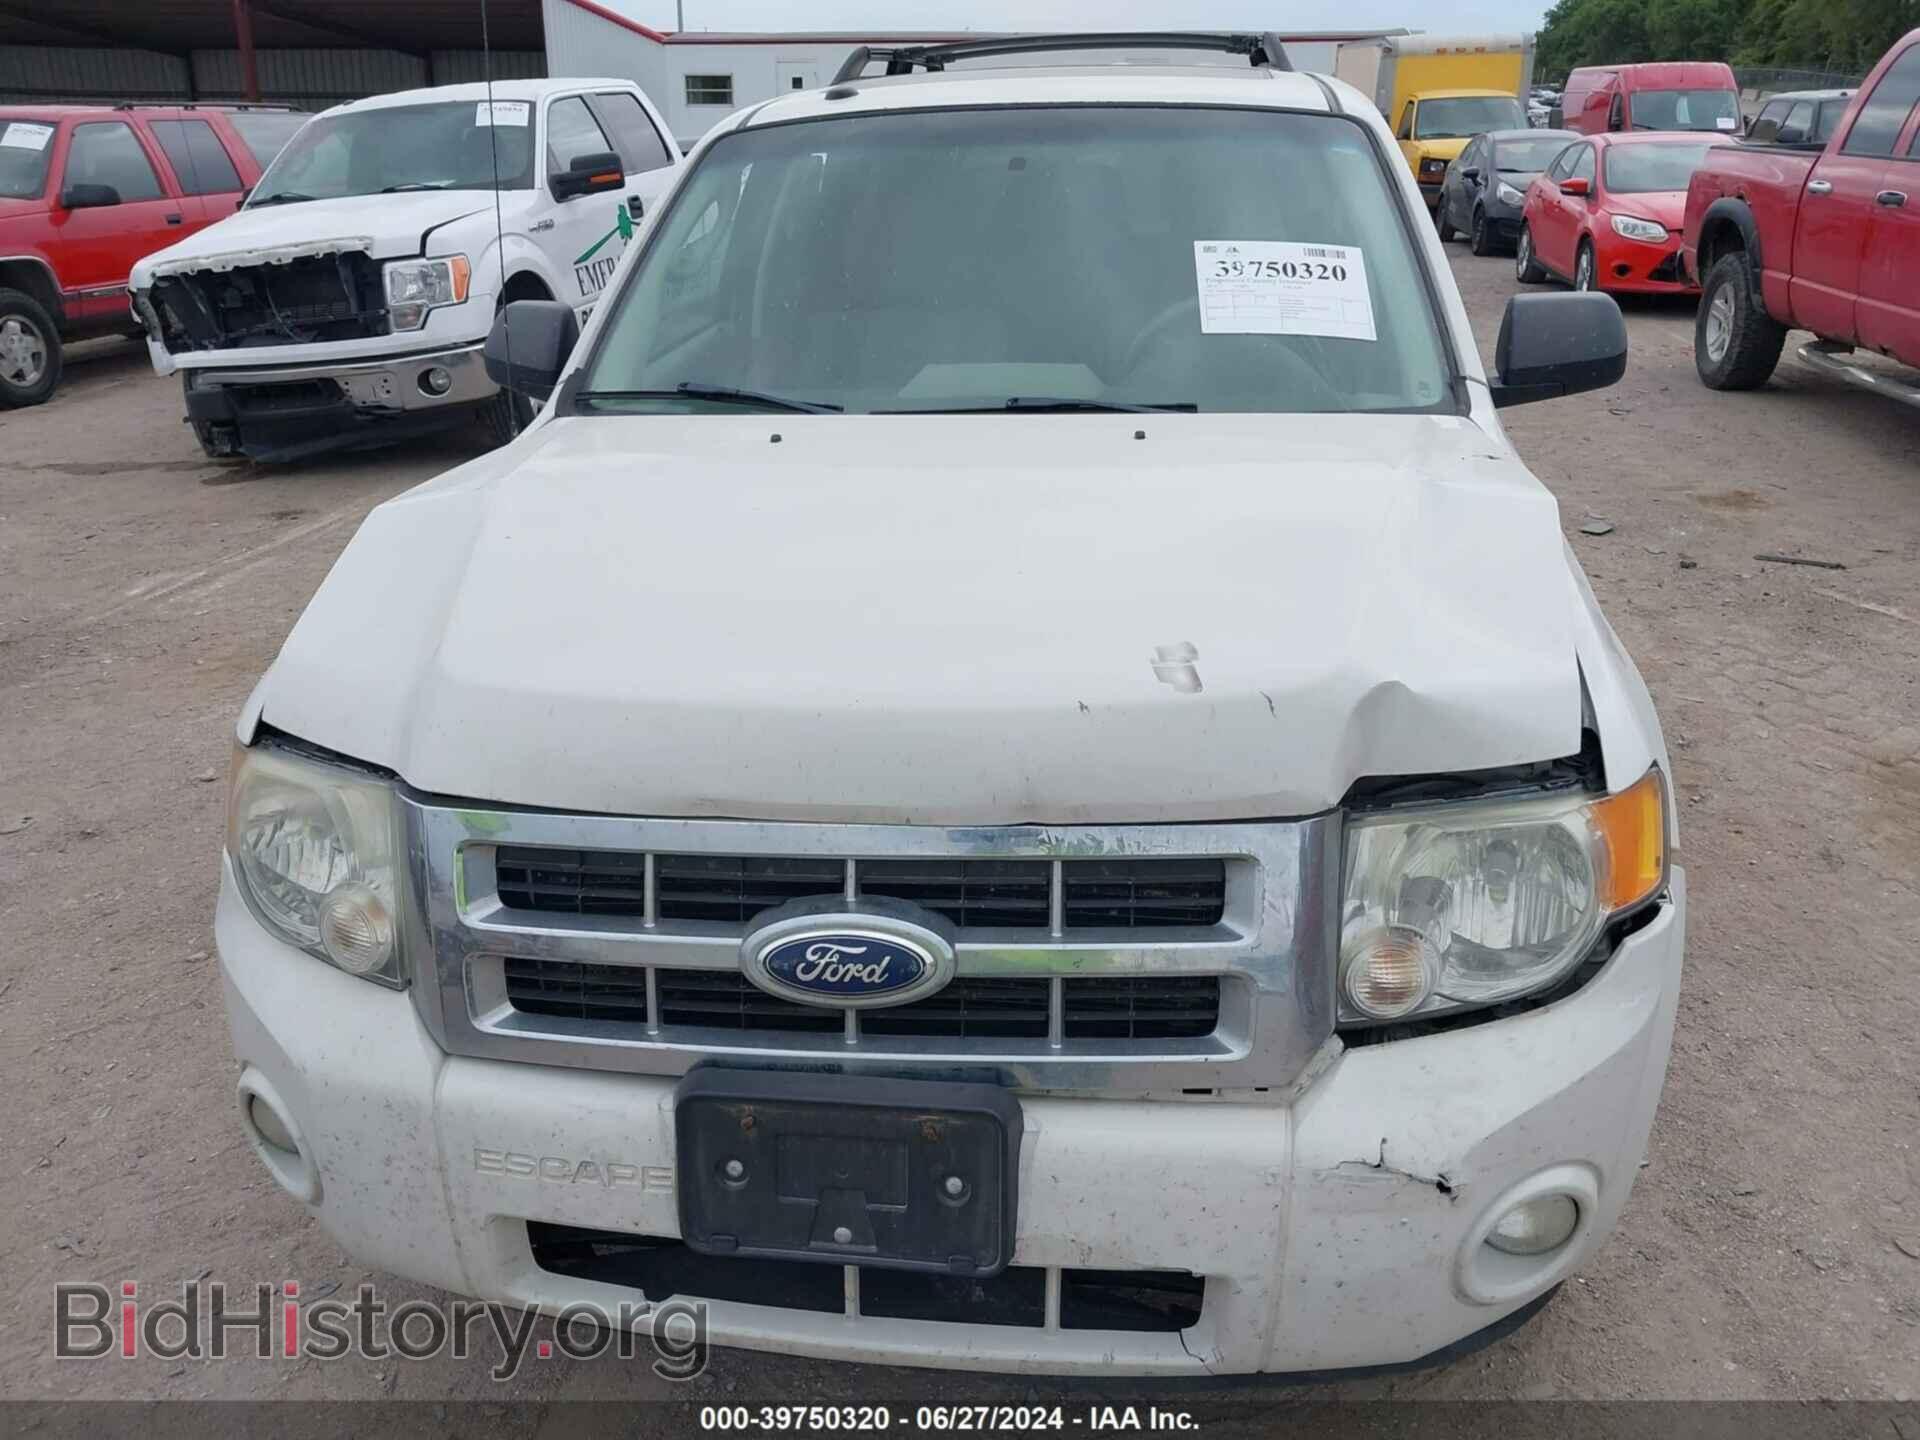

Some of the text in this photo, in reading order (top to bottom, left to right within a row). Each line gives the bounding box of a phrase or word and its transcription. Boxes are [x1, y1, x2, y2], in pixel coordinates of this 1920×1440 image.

[575, 256, 620, 297] EMER
[1215, 260, 1347, 282] 39750320
[796, 943, 891, 983] Ford
[474, 1148, 674, 1193] ESCAPE
